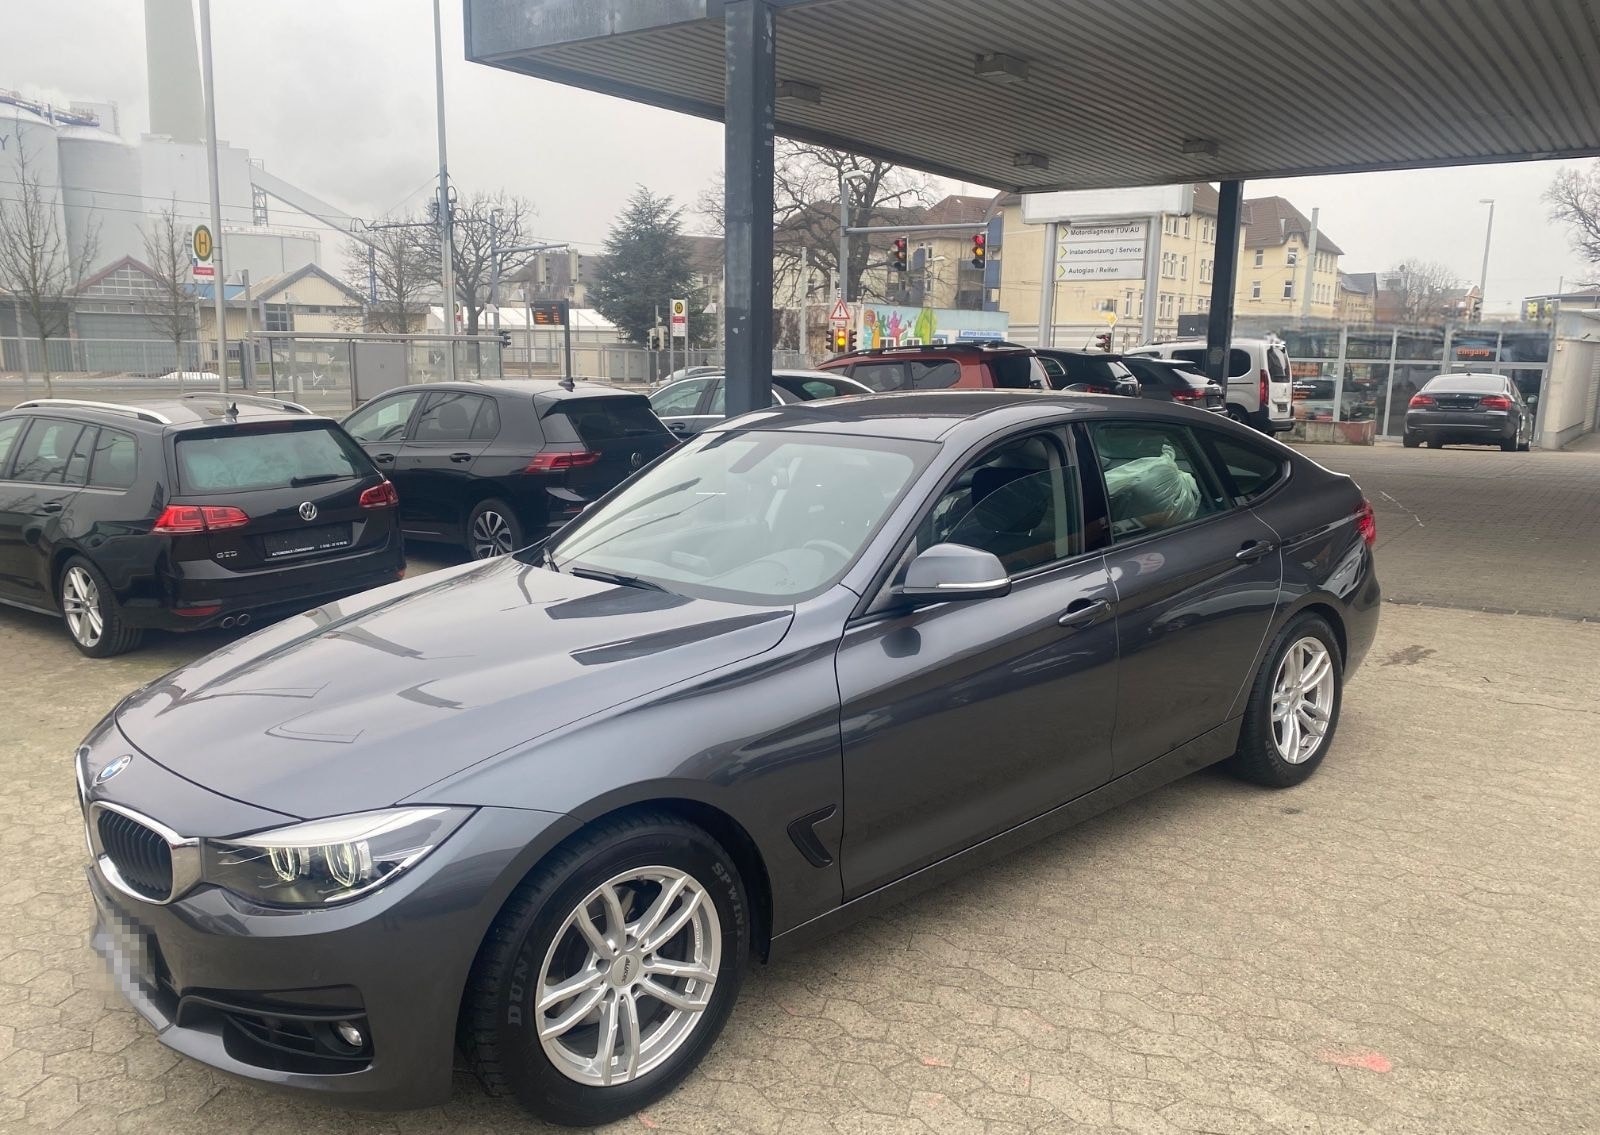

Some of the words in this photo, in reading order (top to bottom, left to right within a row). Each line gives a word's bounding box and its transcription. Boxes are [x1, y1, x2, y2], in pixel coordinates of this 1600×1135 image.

[199, 233, 207, 253] H
[1069, 247, 1114, 255] Instandsetzung
[1457, 347, 1489, 356] Eingang
